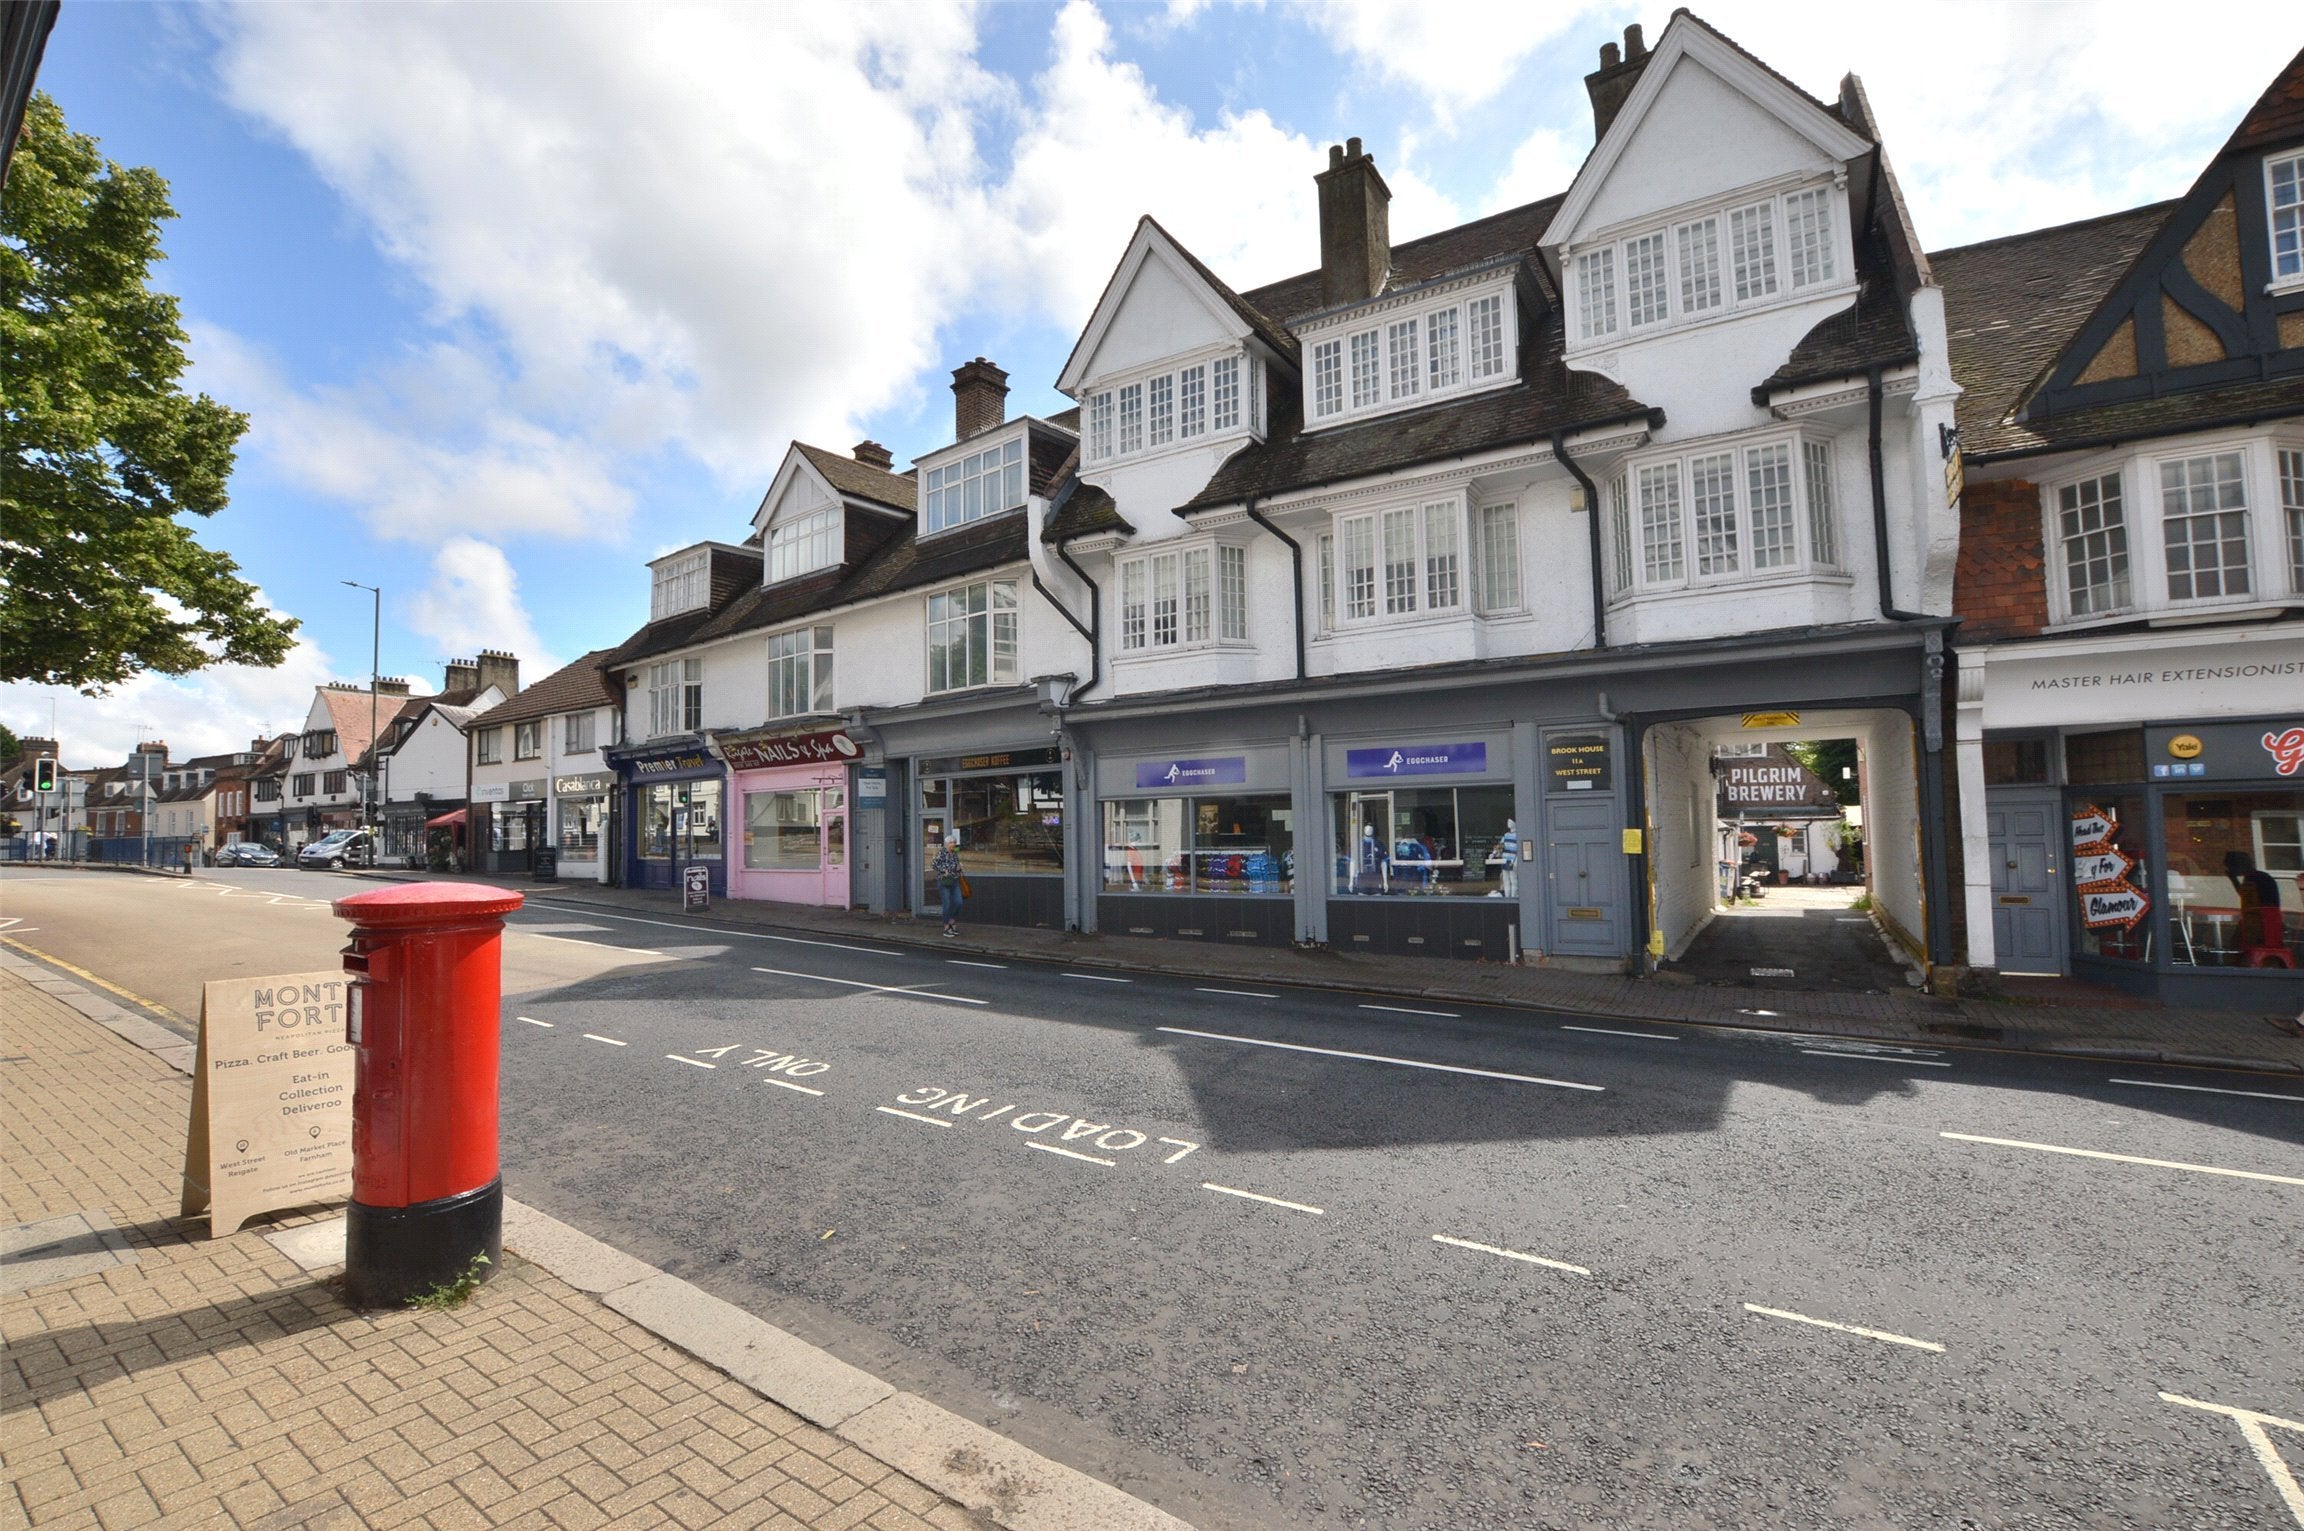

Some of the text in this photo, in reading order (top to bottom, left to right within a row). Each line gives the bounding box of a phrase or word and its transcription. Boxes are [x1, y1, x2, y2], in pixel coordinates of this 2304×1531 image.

[2031, 676, 2101, 690] MASTER
[2109, 672, 2153, 685] HAIR
[754, 741, 800, 762] NAILS
[800, 744, 812, 758] &
[810, 739, 834, 760] Spa
[1551, 745, 1604, 755] BROOK HOUSE
[2176, 743, 2198, 752] Yale
[635, 754, 704, 773] Premier Travel
[1405, 755, 1449, 765] EGGCHASER
[1182, 768, 1216, 777] EGGCHASER
[1575, 767, 1602, 775] STREET
[1731, 767, 1801, 783] PILGRIM
[556, 776, 601, 793] Casablanca
[1728, 784, 1807, 801] BREWERY
[2099, 857, 2114, 874] For
[2090, 897, 2137, 916] Glamour
[254, 981, 351, 1009] MONT
[275, 1031, 322, 1040] NEAPOLITAN
[215, 1059, 253, 1069] Pizza.
[257, 1052, 289, 1064] Craft
[292, 1047, 323, 1059] Beer.
[292, 1071, 330, 1084] Eat-in
[279, 1084, 343, 1101] Collection
[282, 1099, 342, 1116] Deliveroo
[695, 1044, 1200, 1164] LOADING ONLY
[284, 1139, 346, 1157] Old Market Place
[300, 1151, 333, 1162] Farnham
[220, 1155, 266, 1170] West Street
[228, 1166, 259, 1177] Reigate
